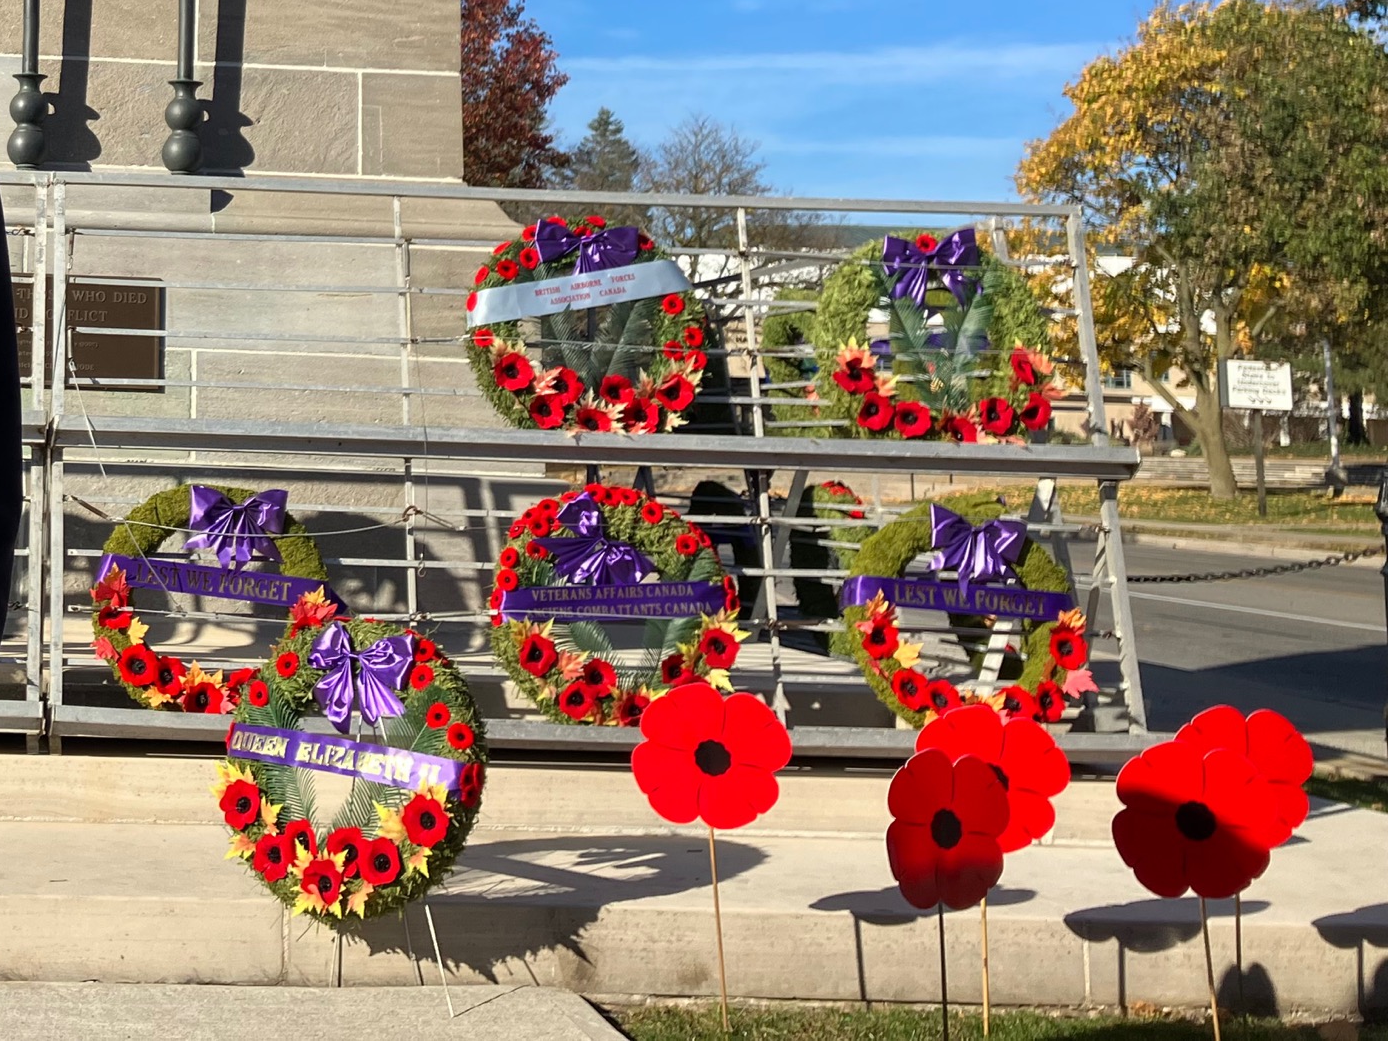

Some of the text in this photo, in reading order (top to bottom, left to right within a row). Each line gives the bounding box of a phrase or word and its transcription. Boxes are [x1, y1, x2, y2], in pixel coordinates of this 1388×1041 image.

[534, 273, 636, 297] BRITISH AIRBORNE FORCES
[550, 286, 627, 305] ASSOCIATION CANADA
[72, 290, 106, 302] WHO
[113, 292, 148, 304] DIED
[136, 563, 292, 602] LEST WE FORGET
[531, 583, 694, 602] VETERANS AFFAIRS CANADA
[576, 603, 662, 617] COMBATTANTS
[665, 601, 713, 614] CANADA
[893, 583, 1047, 616] LEST WE FORGET
[231, 730, 442, 785] QUEEN ELIZABETH II
